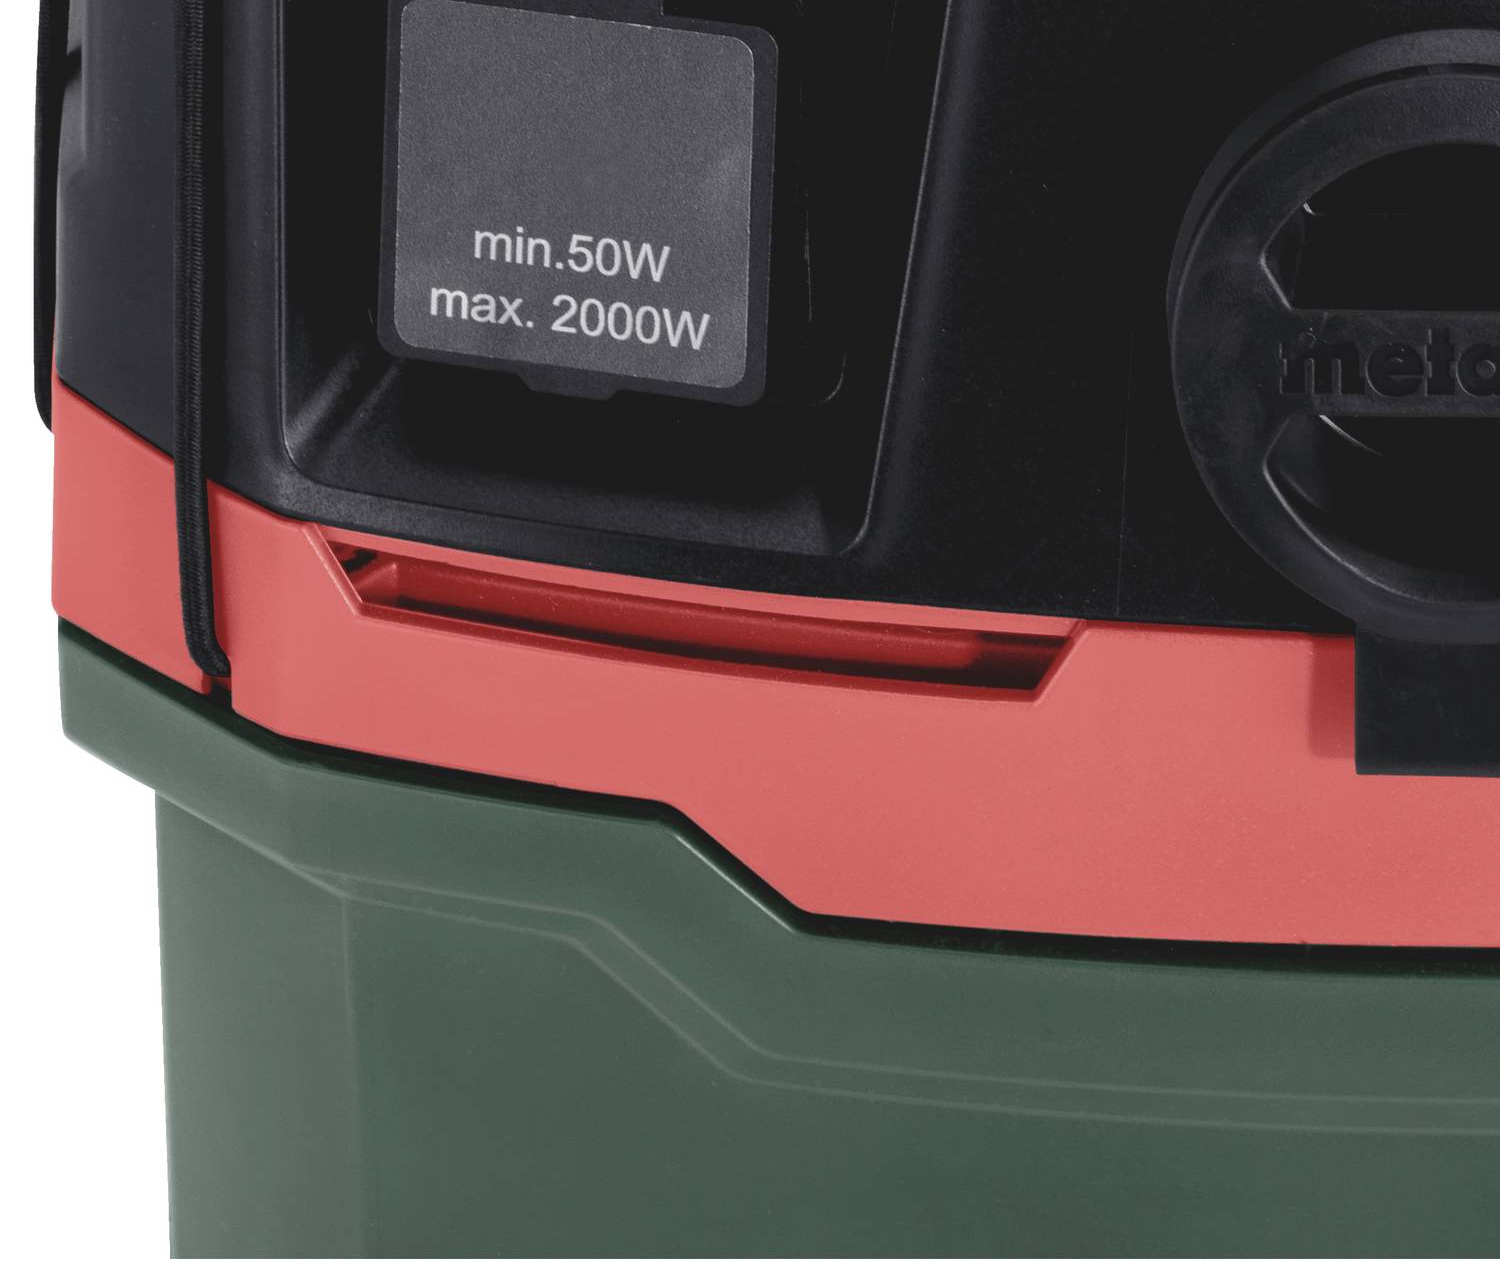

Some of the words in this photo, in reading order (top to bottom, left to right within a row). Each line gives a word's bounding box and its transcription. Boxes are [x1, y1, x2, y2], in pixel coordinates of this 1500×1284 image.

[473, 225, 671, 283] min.50W
[429, 287, 535, 329] max.
[550, 293, 711, 351] 2000W
